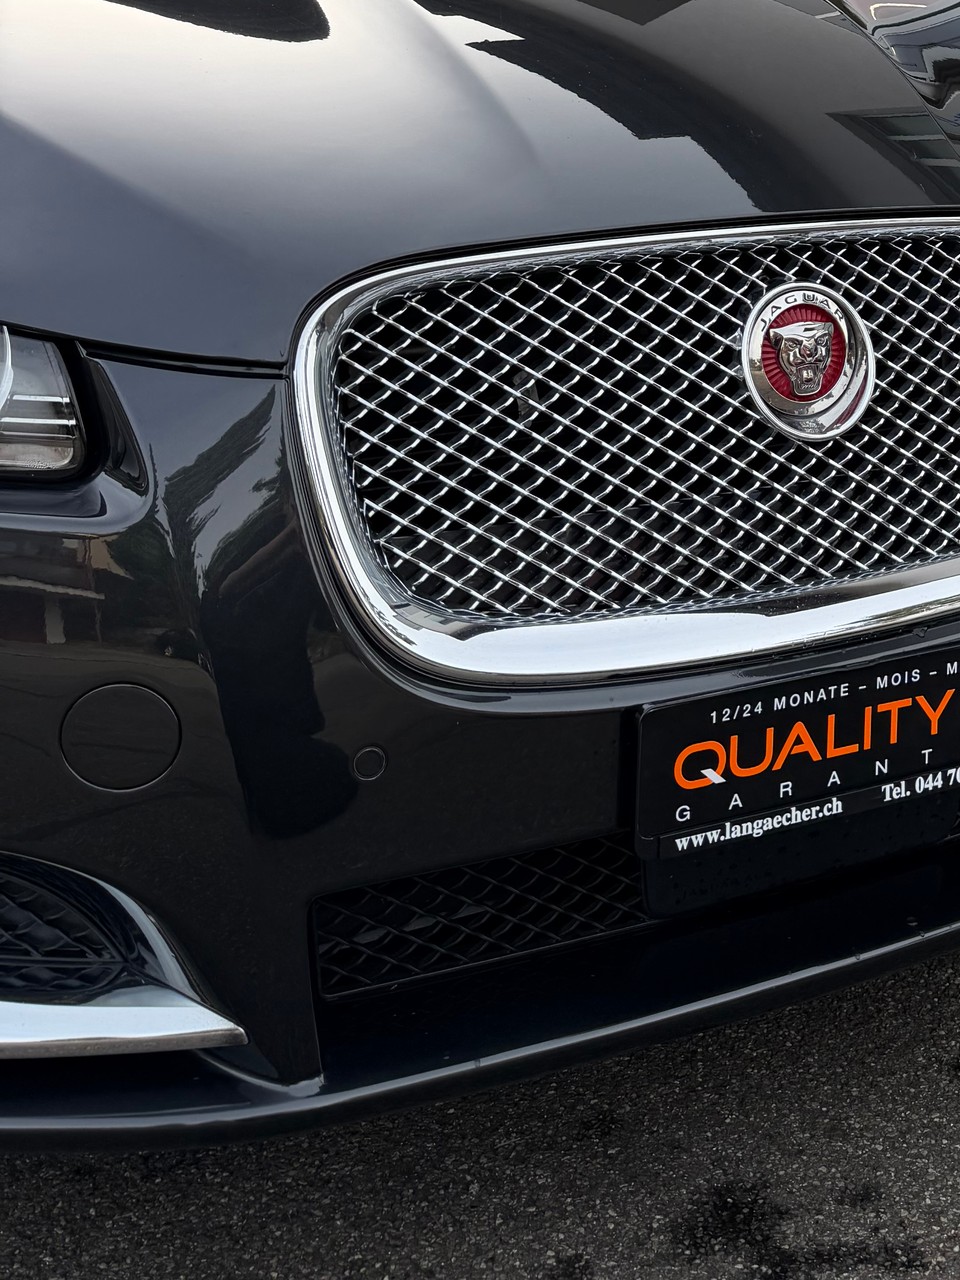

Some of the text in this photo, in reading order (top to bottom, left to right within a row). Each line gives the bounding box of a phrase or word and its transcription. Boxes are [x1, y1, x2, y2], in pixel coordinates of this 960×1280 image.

[760, 291, 845, 332] JAGUAR
[709, 700, 764, 725] 12/24
[773, 683, 850, 711] MONATE
[876, 668, 921, 690] MOIS
[673, 688, 956, 791] QUALITY
[674, 797, 844, 852] www.langaecher.ch
[881, 780, 912, 803] Tel.
[914, 771, 944, 795] 044
